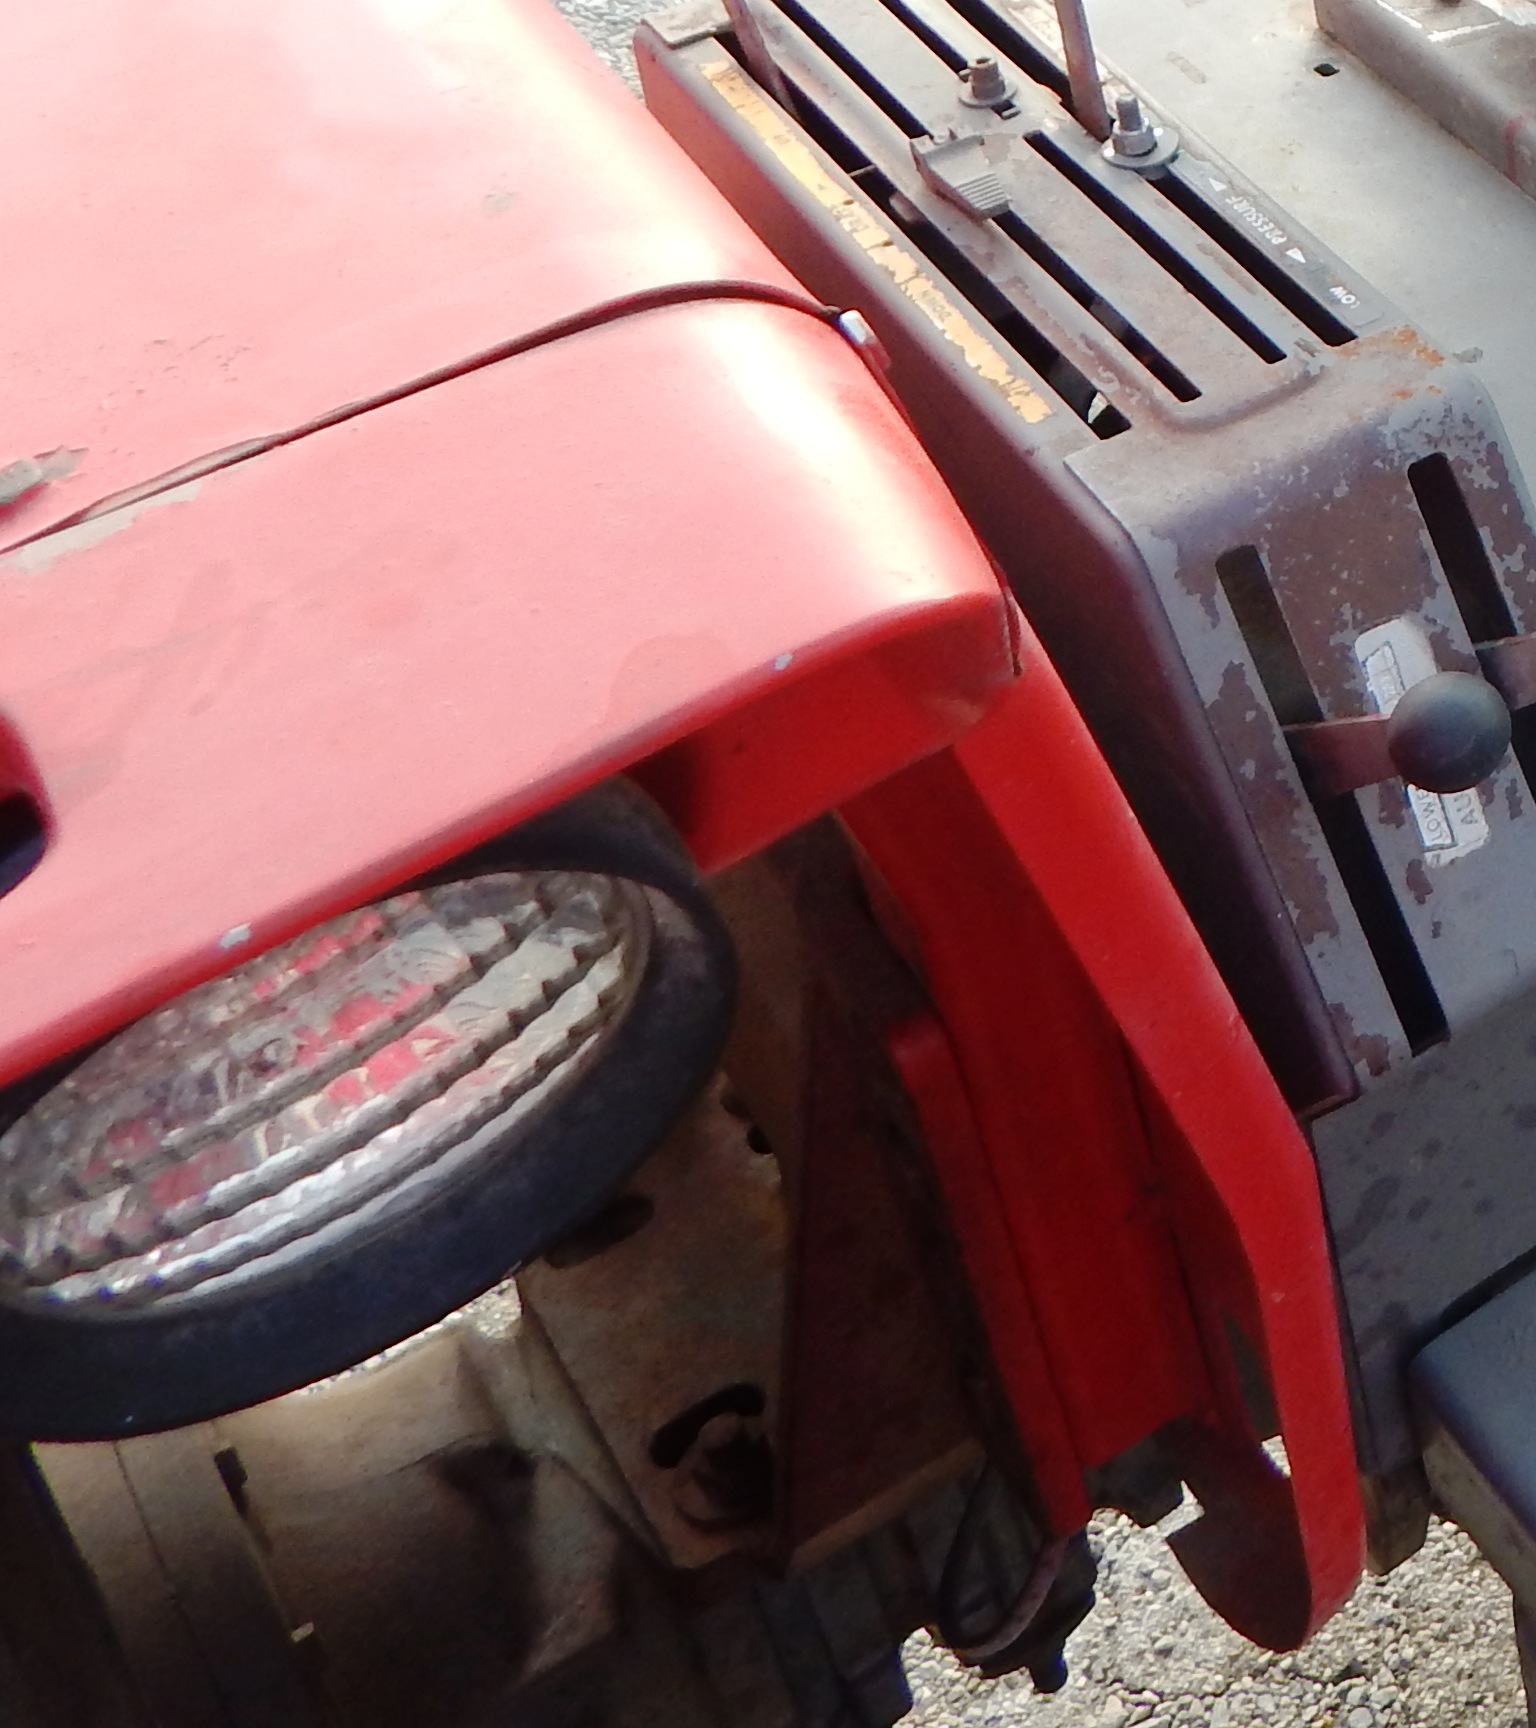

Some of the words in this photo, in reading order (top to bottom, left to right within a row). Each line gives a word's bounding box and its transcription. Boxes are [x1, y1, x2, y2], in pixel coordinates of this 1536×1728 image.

[1329, 285, 1361, 310] LOW
[1415, 788, 1442, 841] LOWE
[1453, 794, 1480, 826] AU
